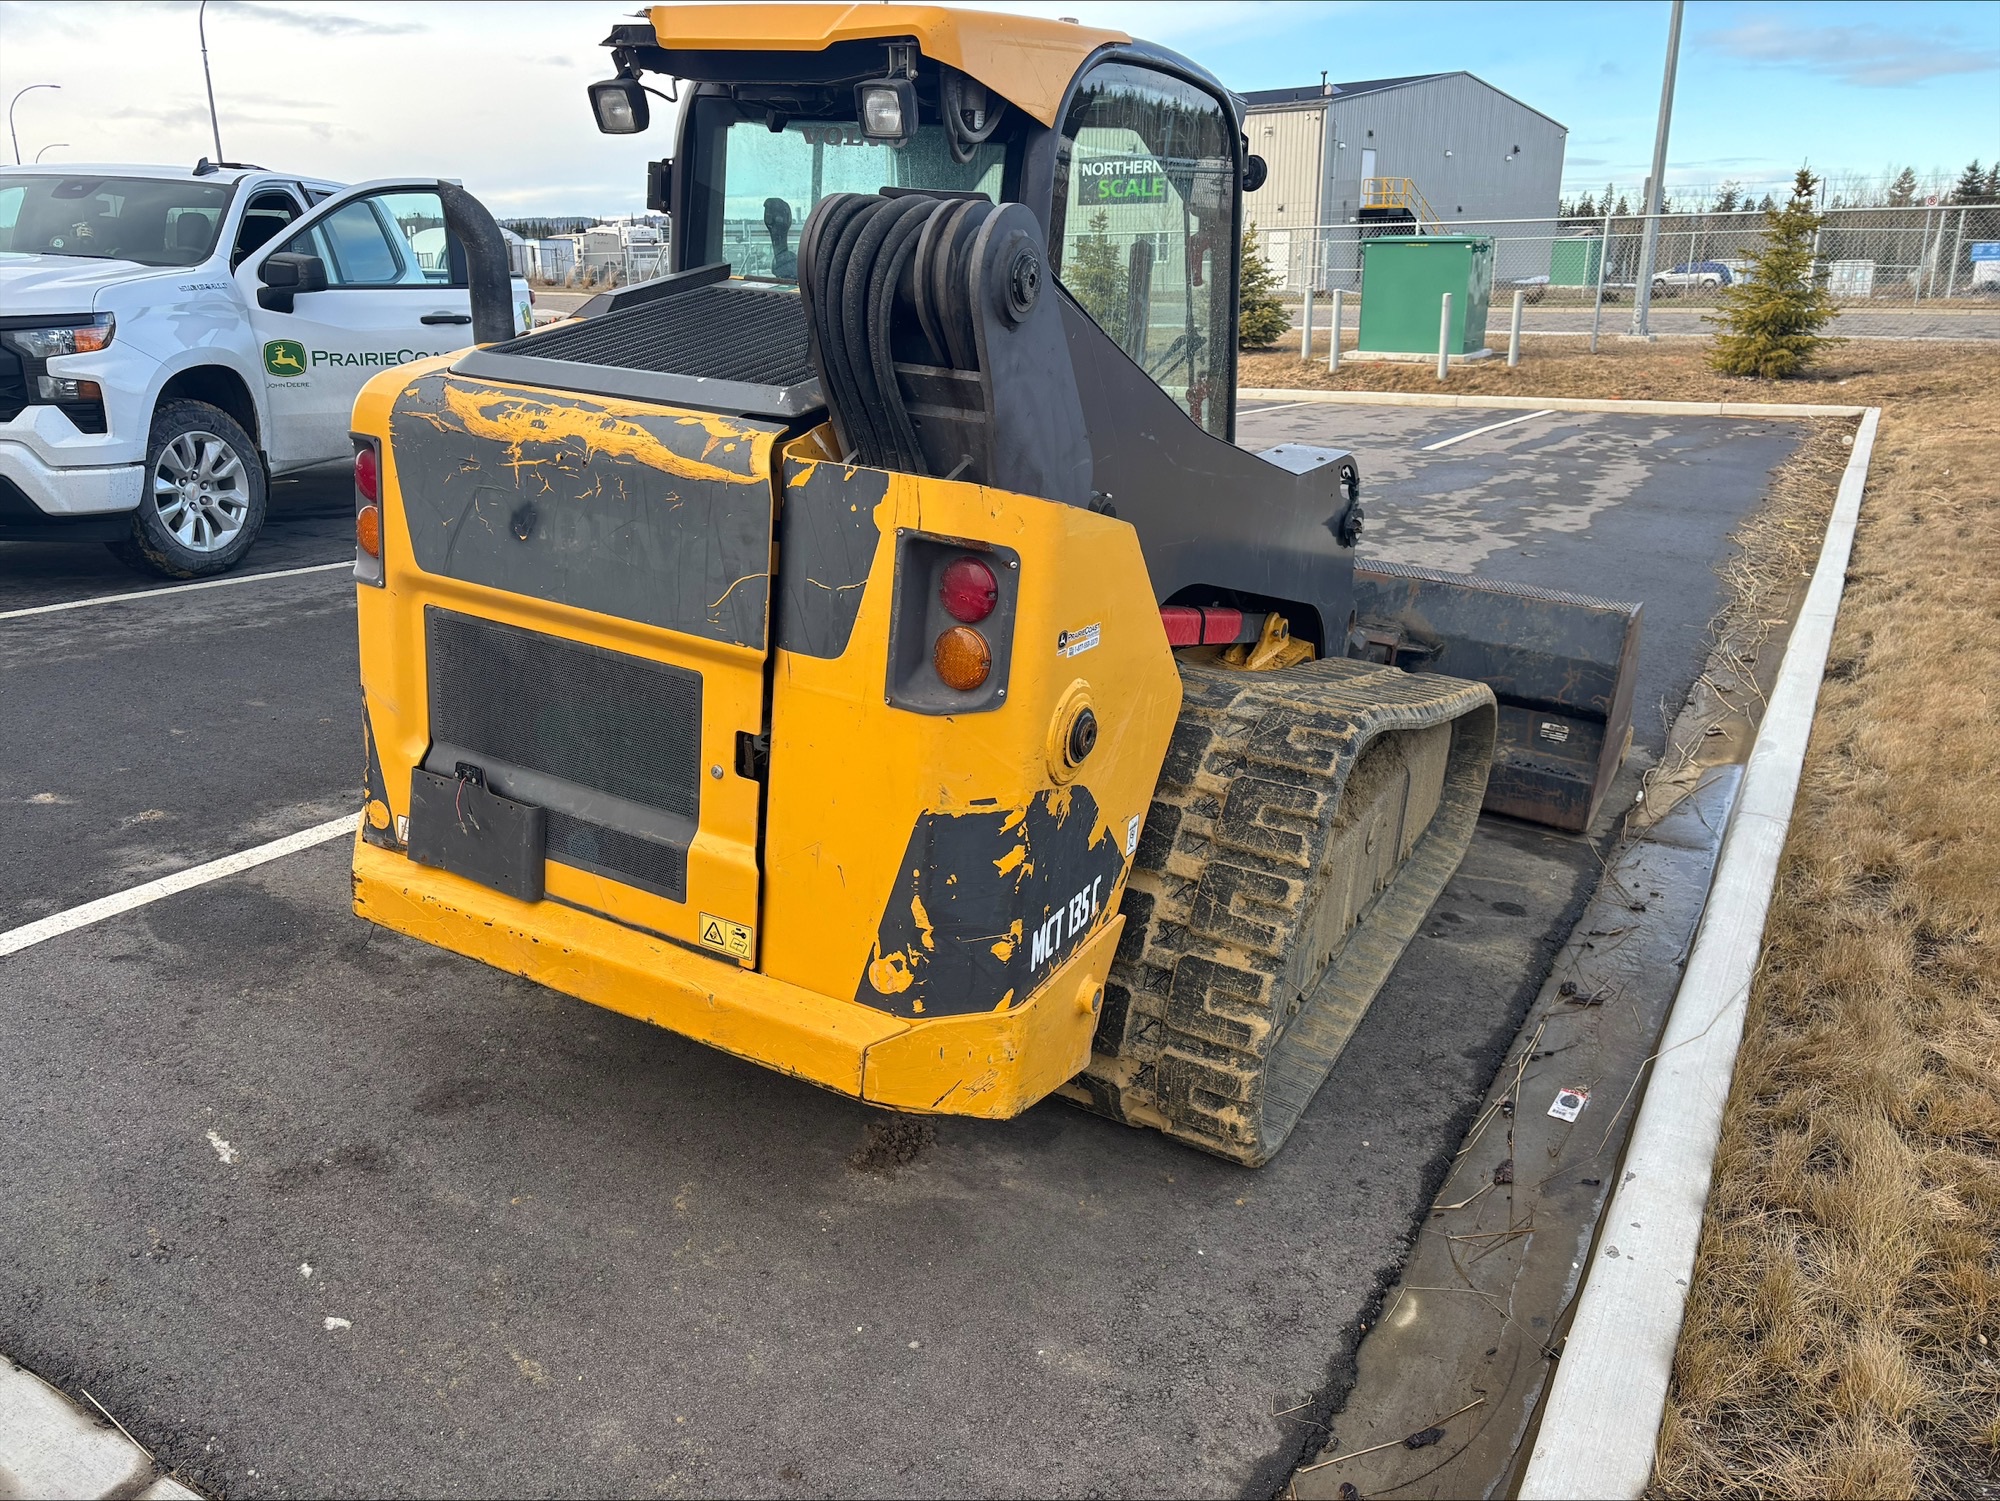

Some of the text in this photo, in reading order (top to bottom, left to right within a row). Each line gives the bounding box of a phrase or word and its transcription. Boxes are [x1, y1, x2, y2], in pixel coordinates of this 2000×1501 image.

[1081, 159, 1164, 177] NORTHERN
[1098, 178, 1165, 199] SCALE
[1031, 906, 1065, 973] MCT
